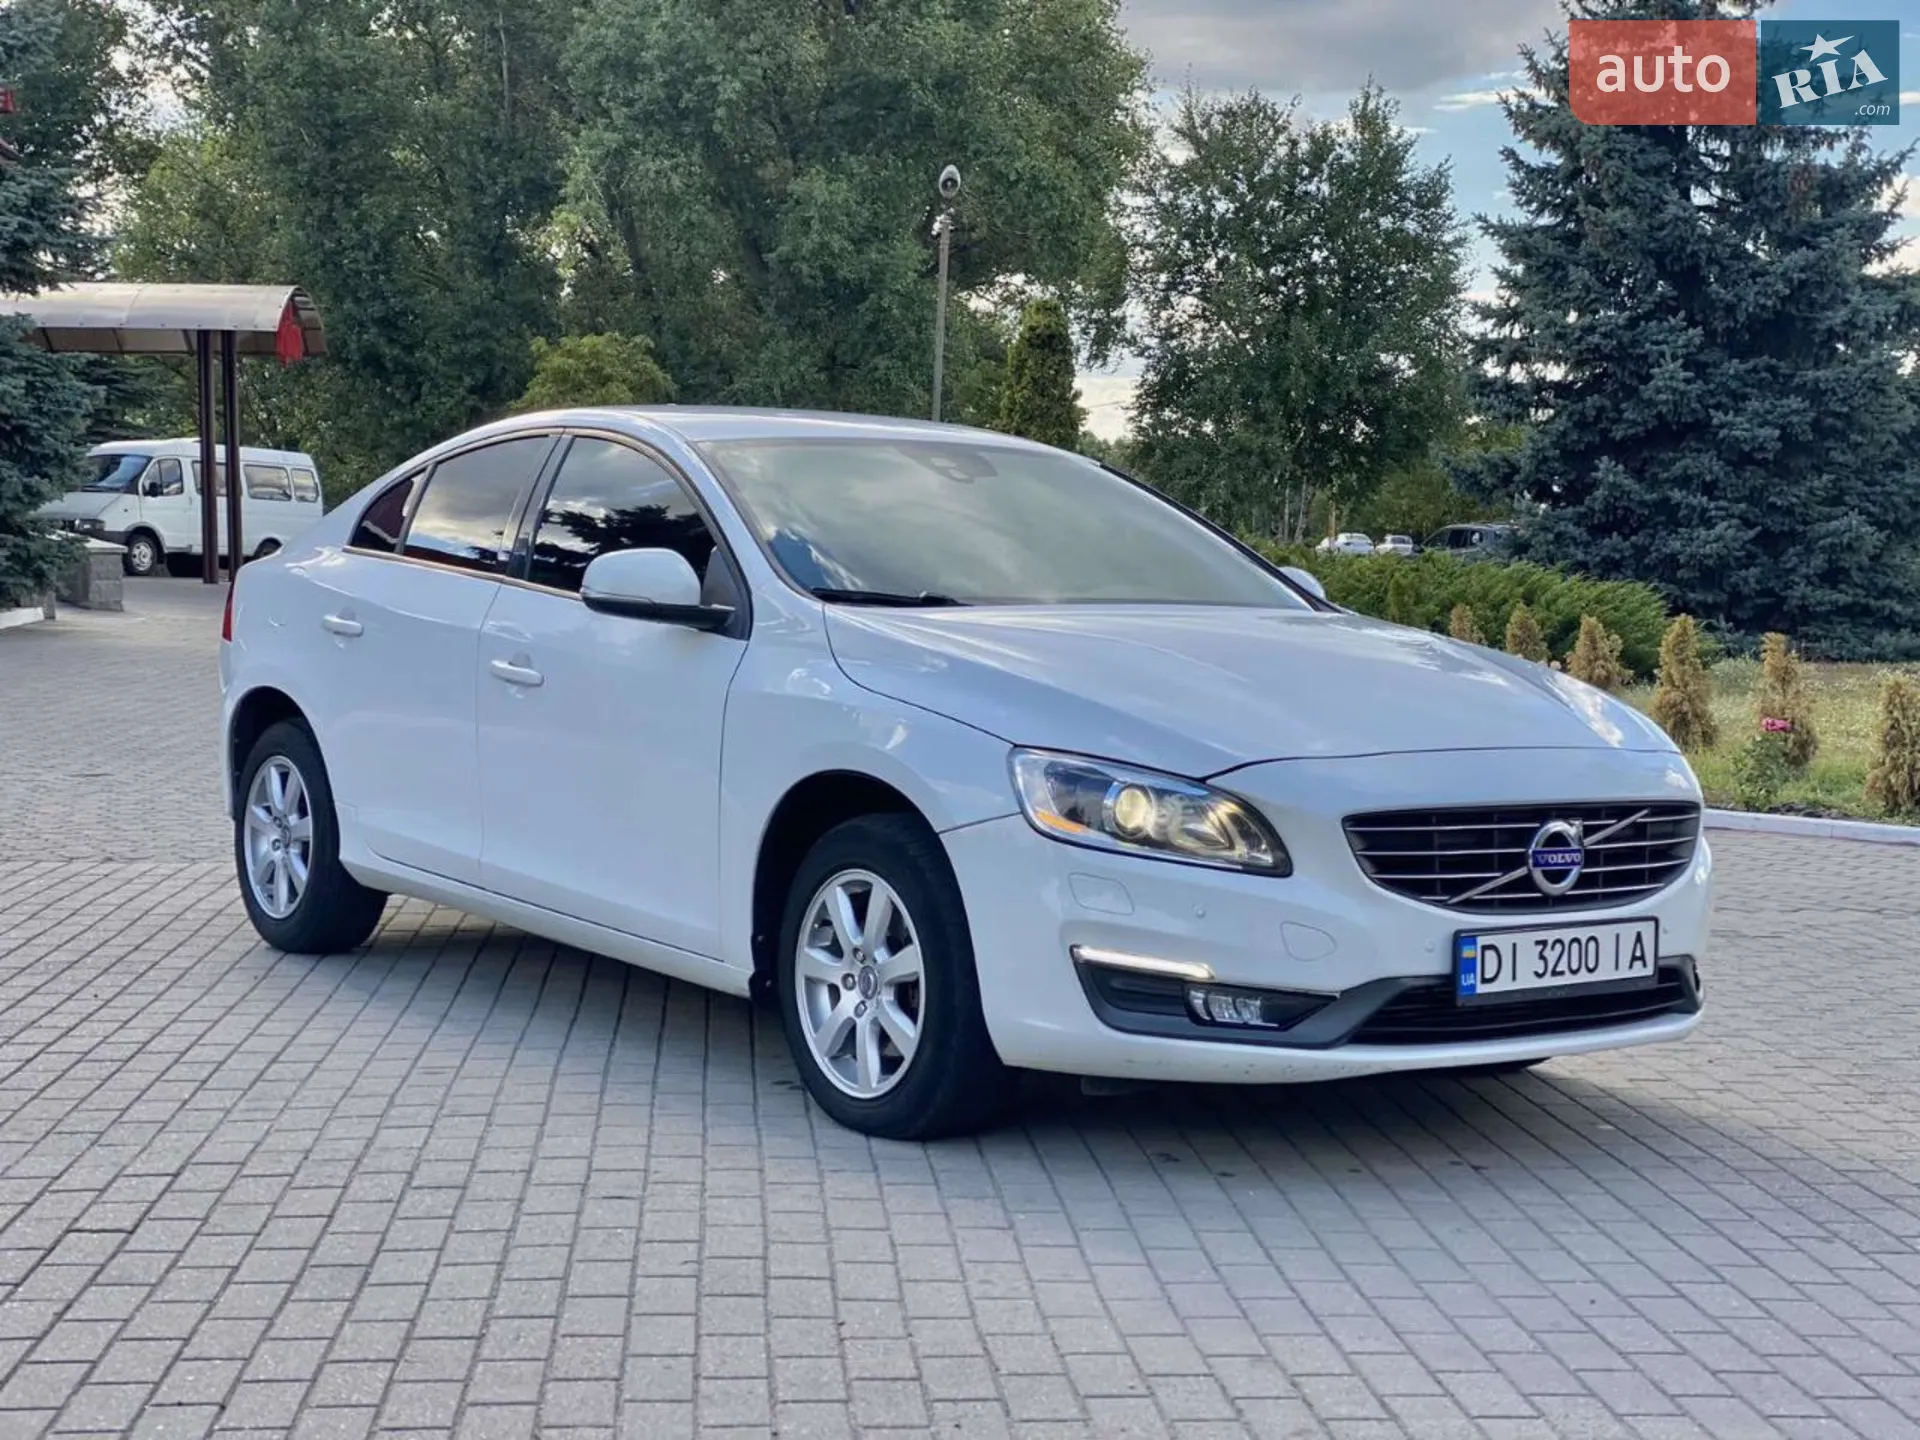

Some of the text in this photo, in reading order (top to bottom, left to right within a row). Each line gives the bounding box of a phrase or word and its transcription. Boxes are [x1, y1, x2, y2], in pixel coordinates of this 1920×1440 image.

[1536, 852, 1581, 865] VOLVO
[1480, 931, 1648, 984] DI 3200 IA
[1461, 973, 1476, 986] UA
